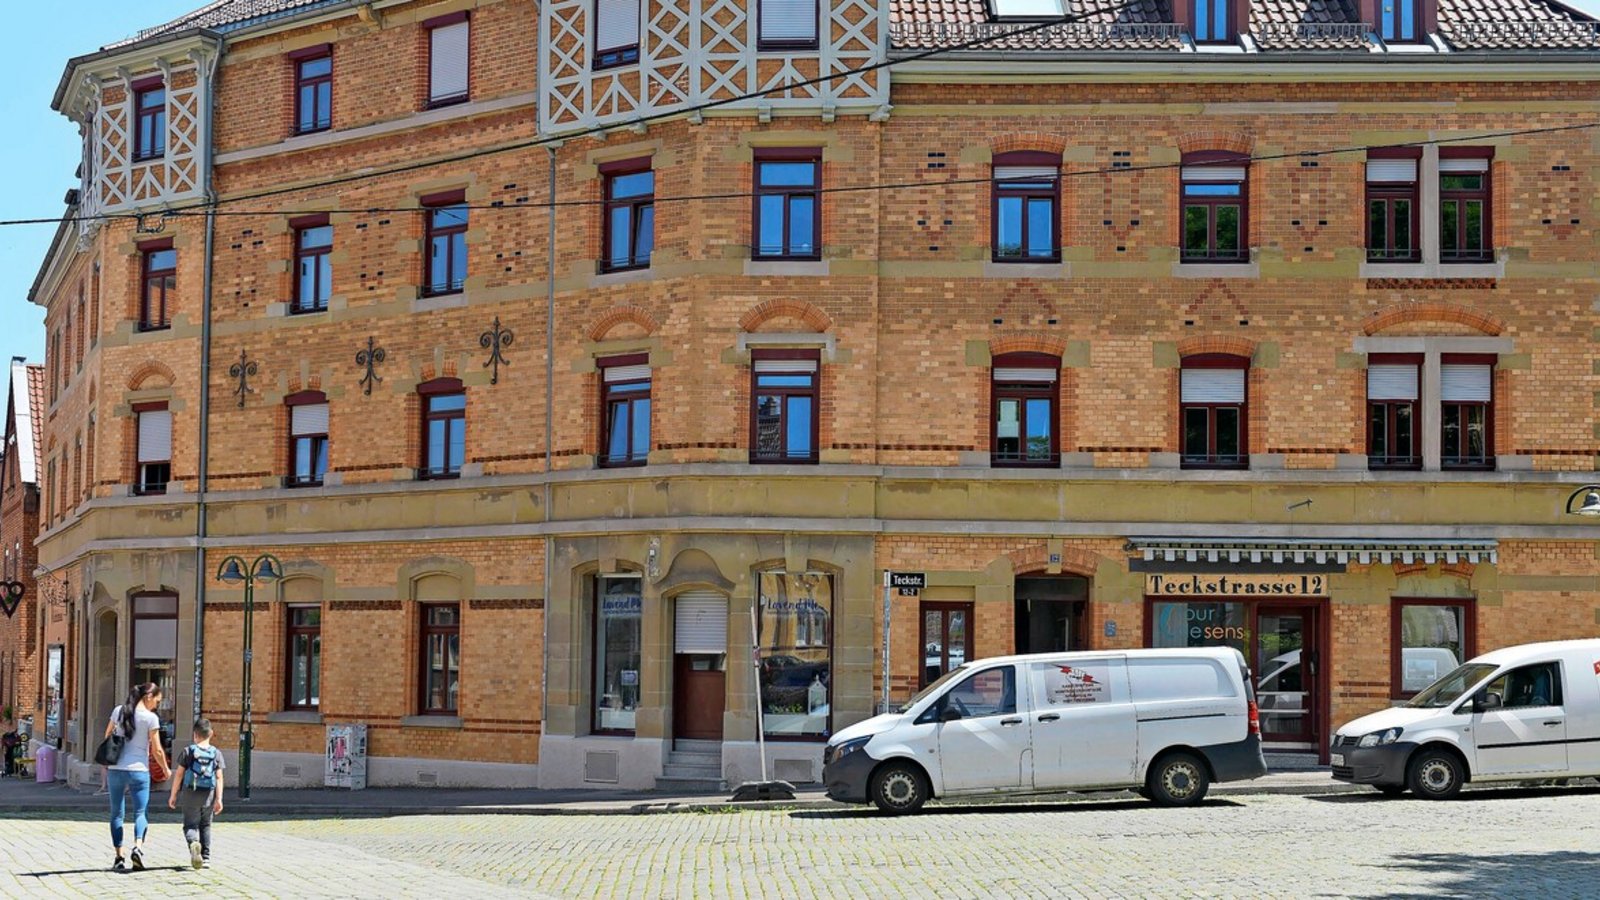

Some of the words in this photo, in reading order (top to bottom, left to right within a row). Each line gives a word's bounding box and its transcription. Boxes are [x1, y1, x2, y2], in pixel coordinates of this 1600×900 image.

[893, 575, 923, 585] Teckstr.
[1150, 575, 1297, 594] Teckstrasse
[1301, 575, 1322, 594] 12
